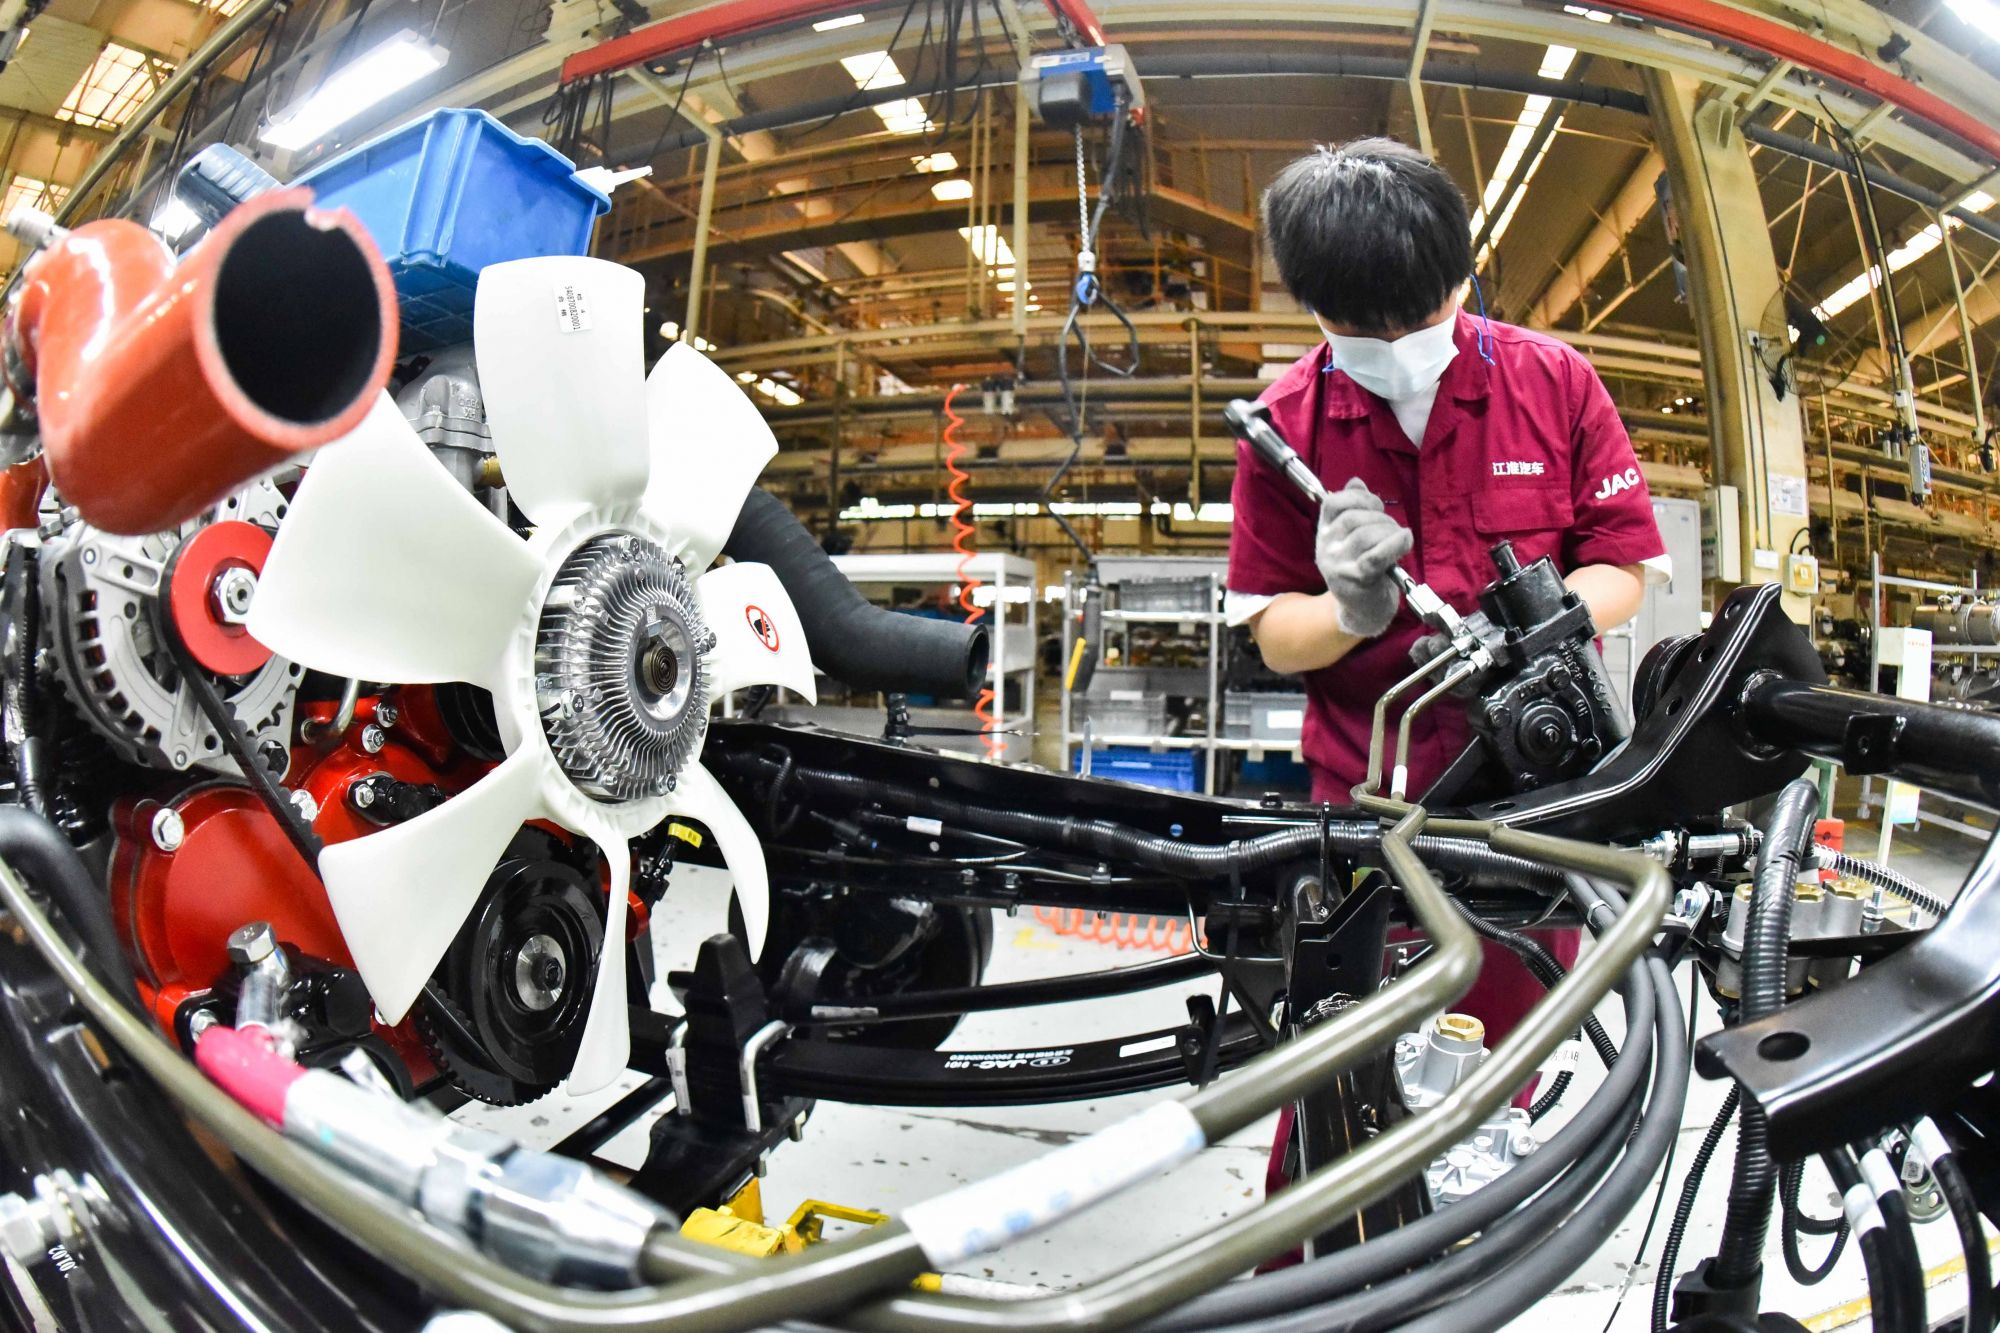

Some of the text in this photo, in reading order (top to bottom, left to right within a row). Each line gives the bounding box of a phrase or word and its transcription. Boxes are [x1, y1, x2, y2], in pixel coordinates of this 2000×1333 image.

[1492, 461, 1545, 476] 江淮汽车
[1595, 467, 1640, 500] JAC
